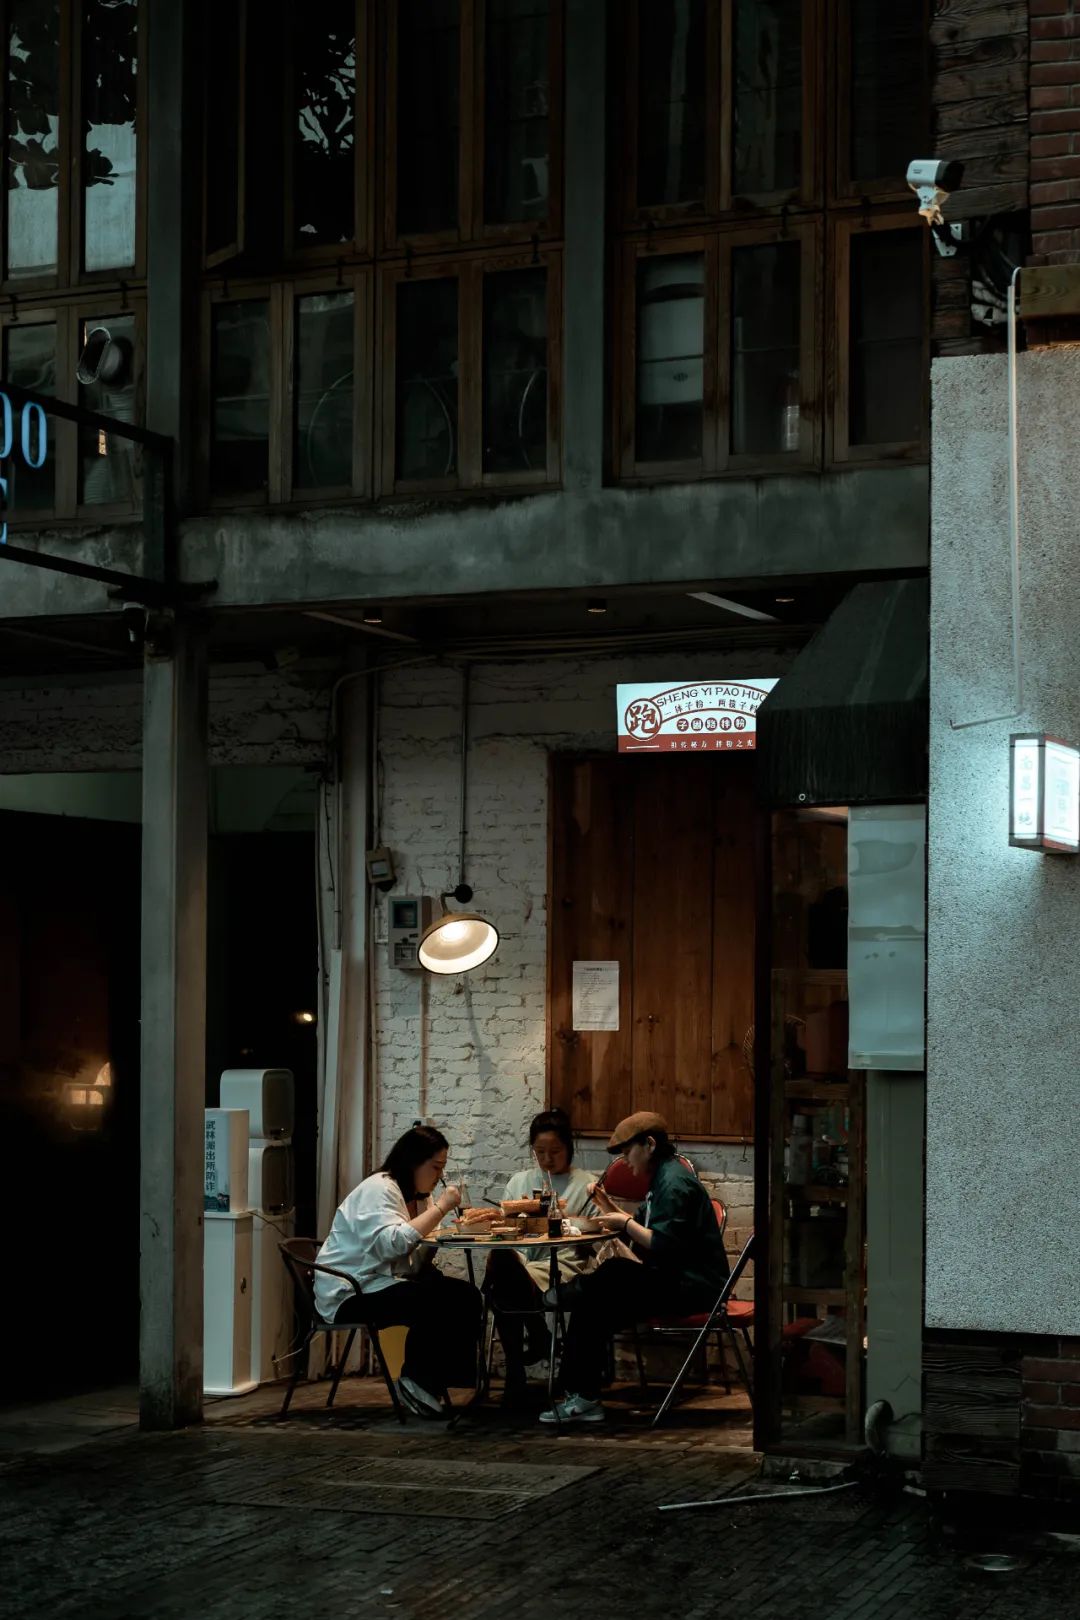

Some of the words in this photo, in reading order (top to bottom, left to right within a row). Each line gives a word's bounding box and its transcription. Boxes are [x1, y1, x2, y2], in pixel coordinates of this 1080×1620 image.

[656, 689, 698, 707] SHENG
[701, 687, 712, 696] YI
[715, 687, 739, 697] PAO
[628, 703, 659, 734] 跑
[205, 1120, 216, 1192] 武林派出所防诈
